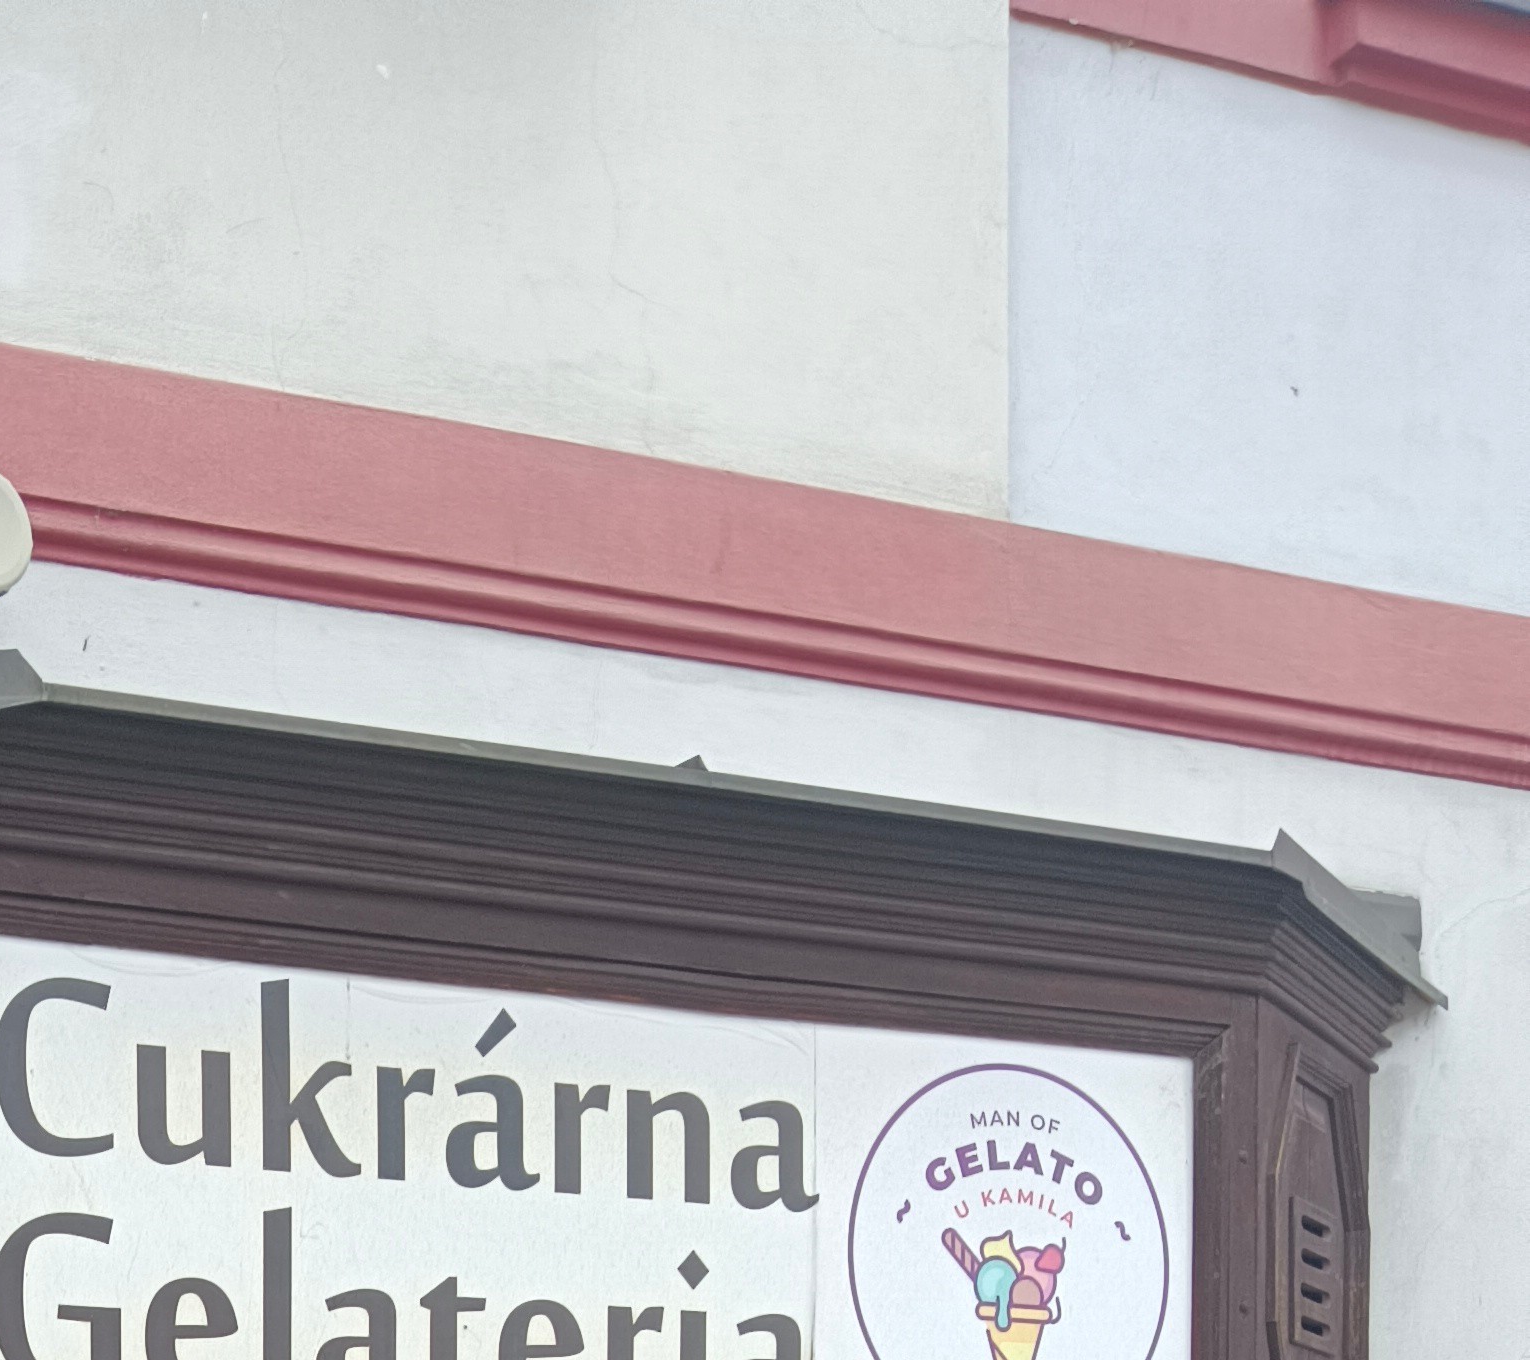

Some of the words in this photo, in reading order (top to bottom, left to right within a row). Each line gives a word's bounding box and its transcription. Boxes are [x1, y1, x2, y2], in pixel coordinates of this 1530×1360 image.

[970, 1110, 1020, 1130] MAN
[1030, 1114, 1061, 1134] OF
[925, 1140, 1103, 1205] GELATO
[954, 1201, 970, 1219] U
[981, 1188, 1074, 1228] KAMILA
